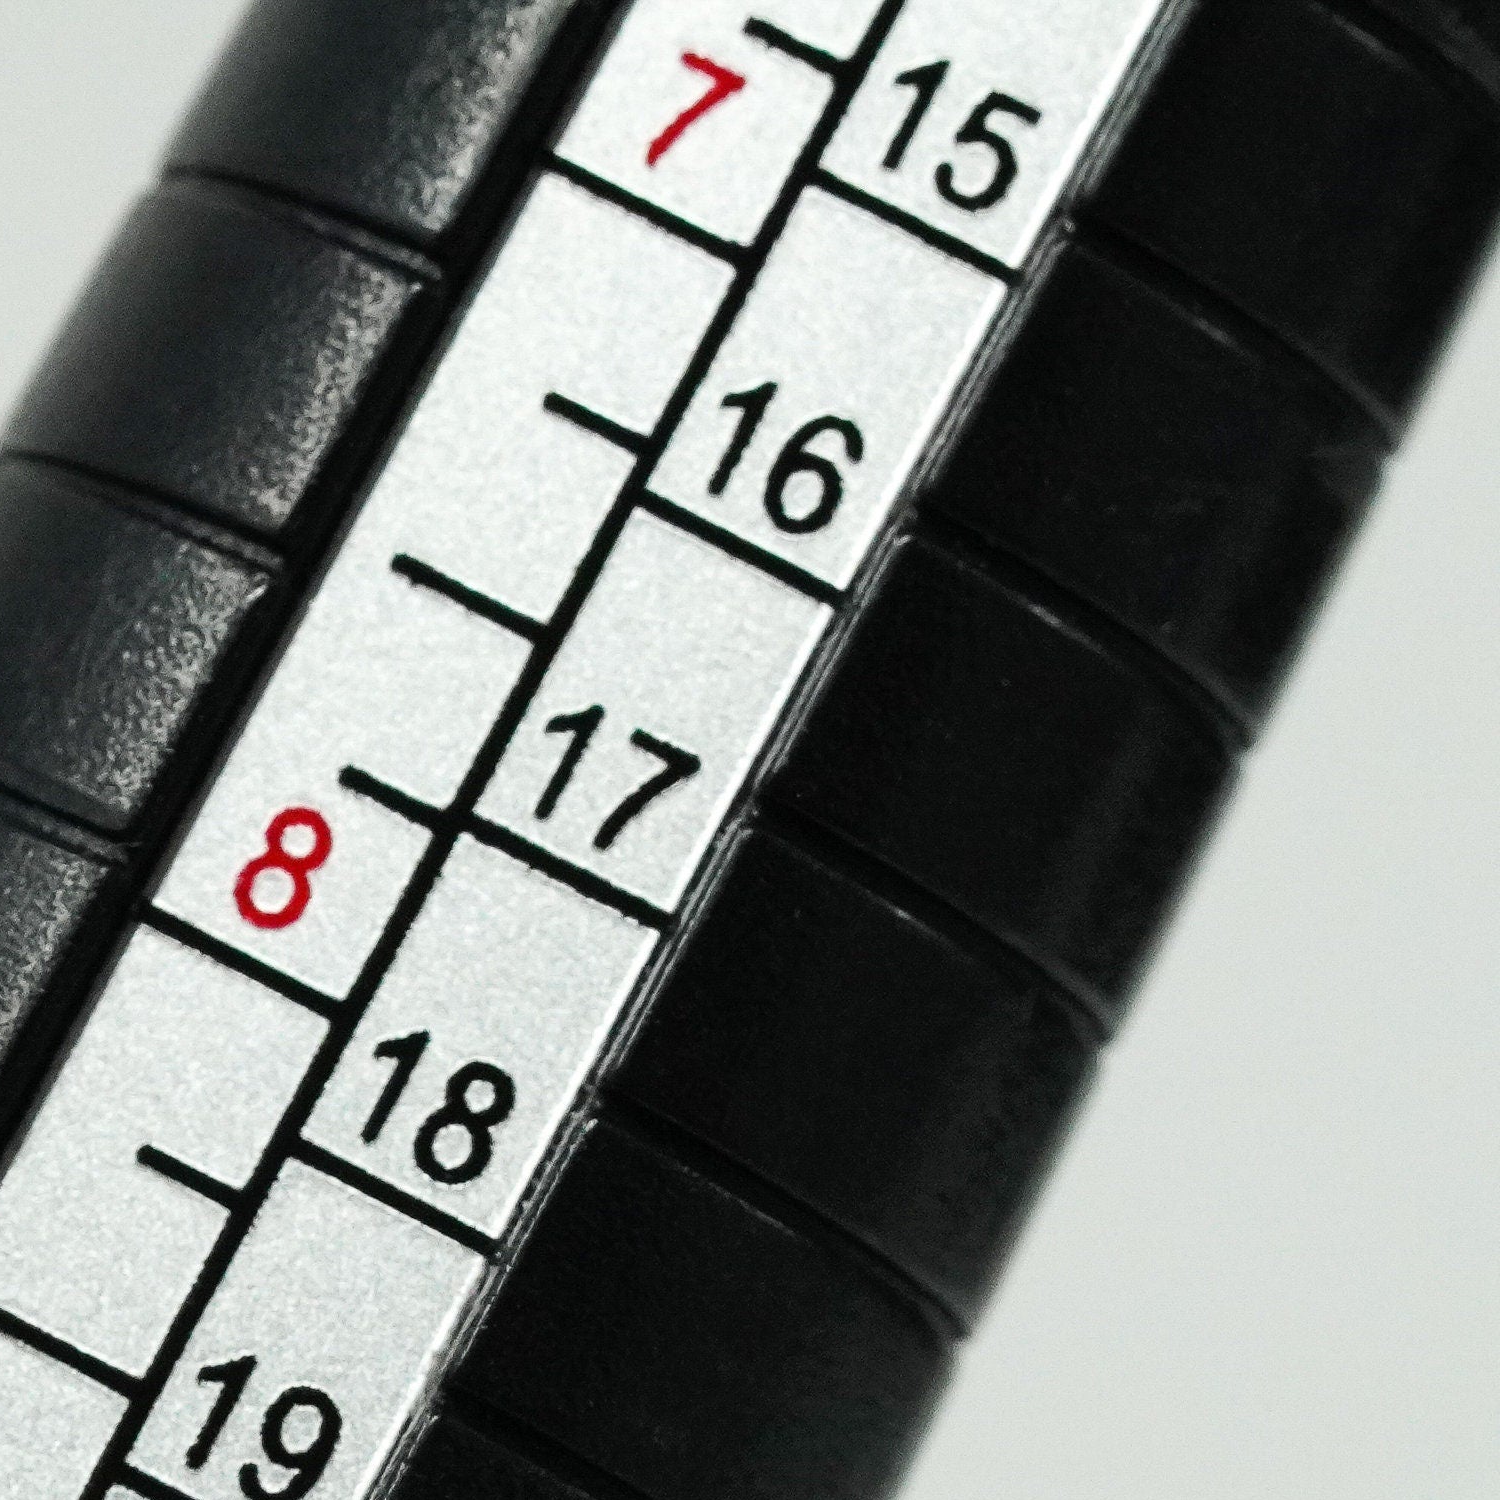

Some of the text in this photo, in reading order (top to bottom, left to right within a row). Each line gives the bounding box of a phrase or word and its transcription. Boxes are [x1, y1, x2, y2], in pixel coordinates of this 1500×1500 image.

[647, 53, 746, 167] 7
[882, 60, 1041, 213] 15
[707, 381, 865, 535] 16
[534, 704, 702, 851] 17
[233, 807, 332, 930] 8
[360, 1030, 517, 1186] 18
